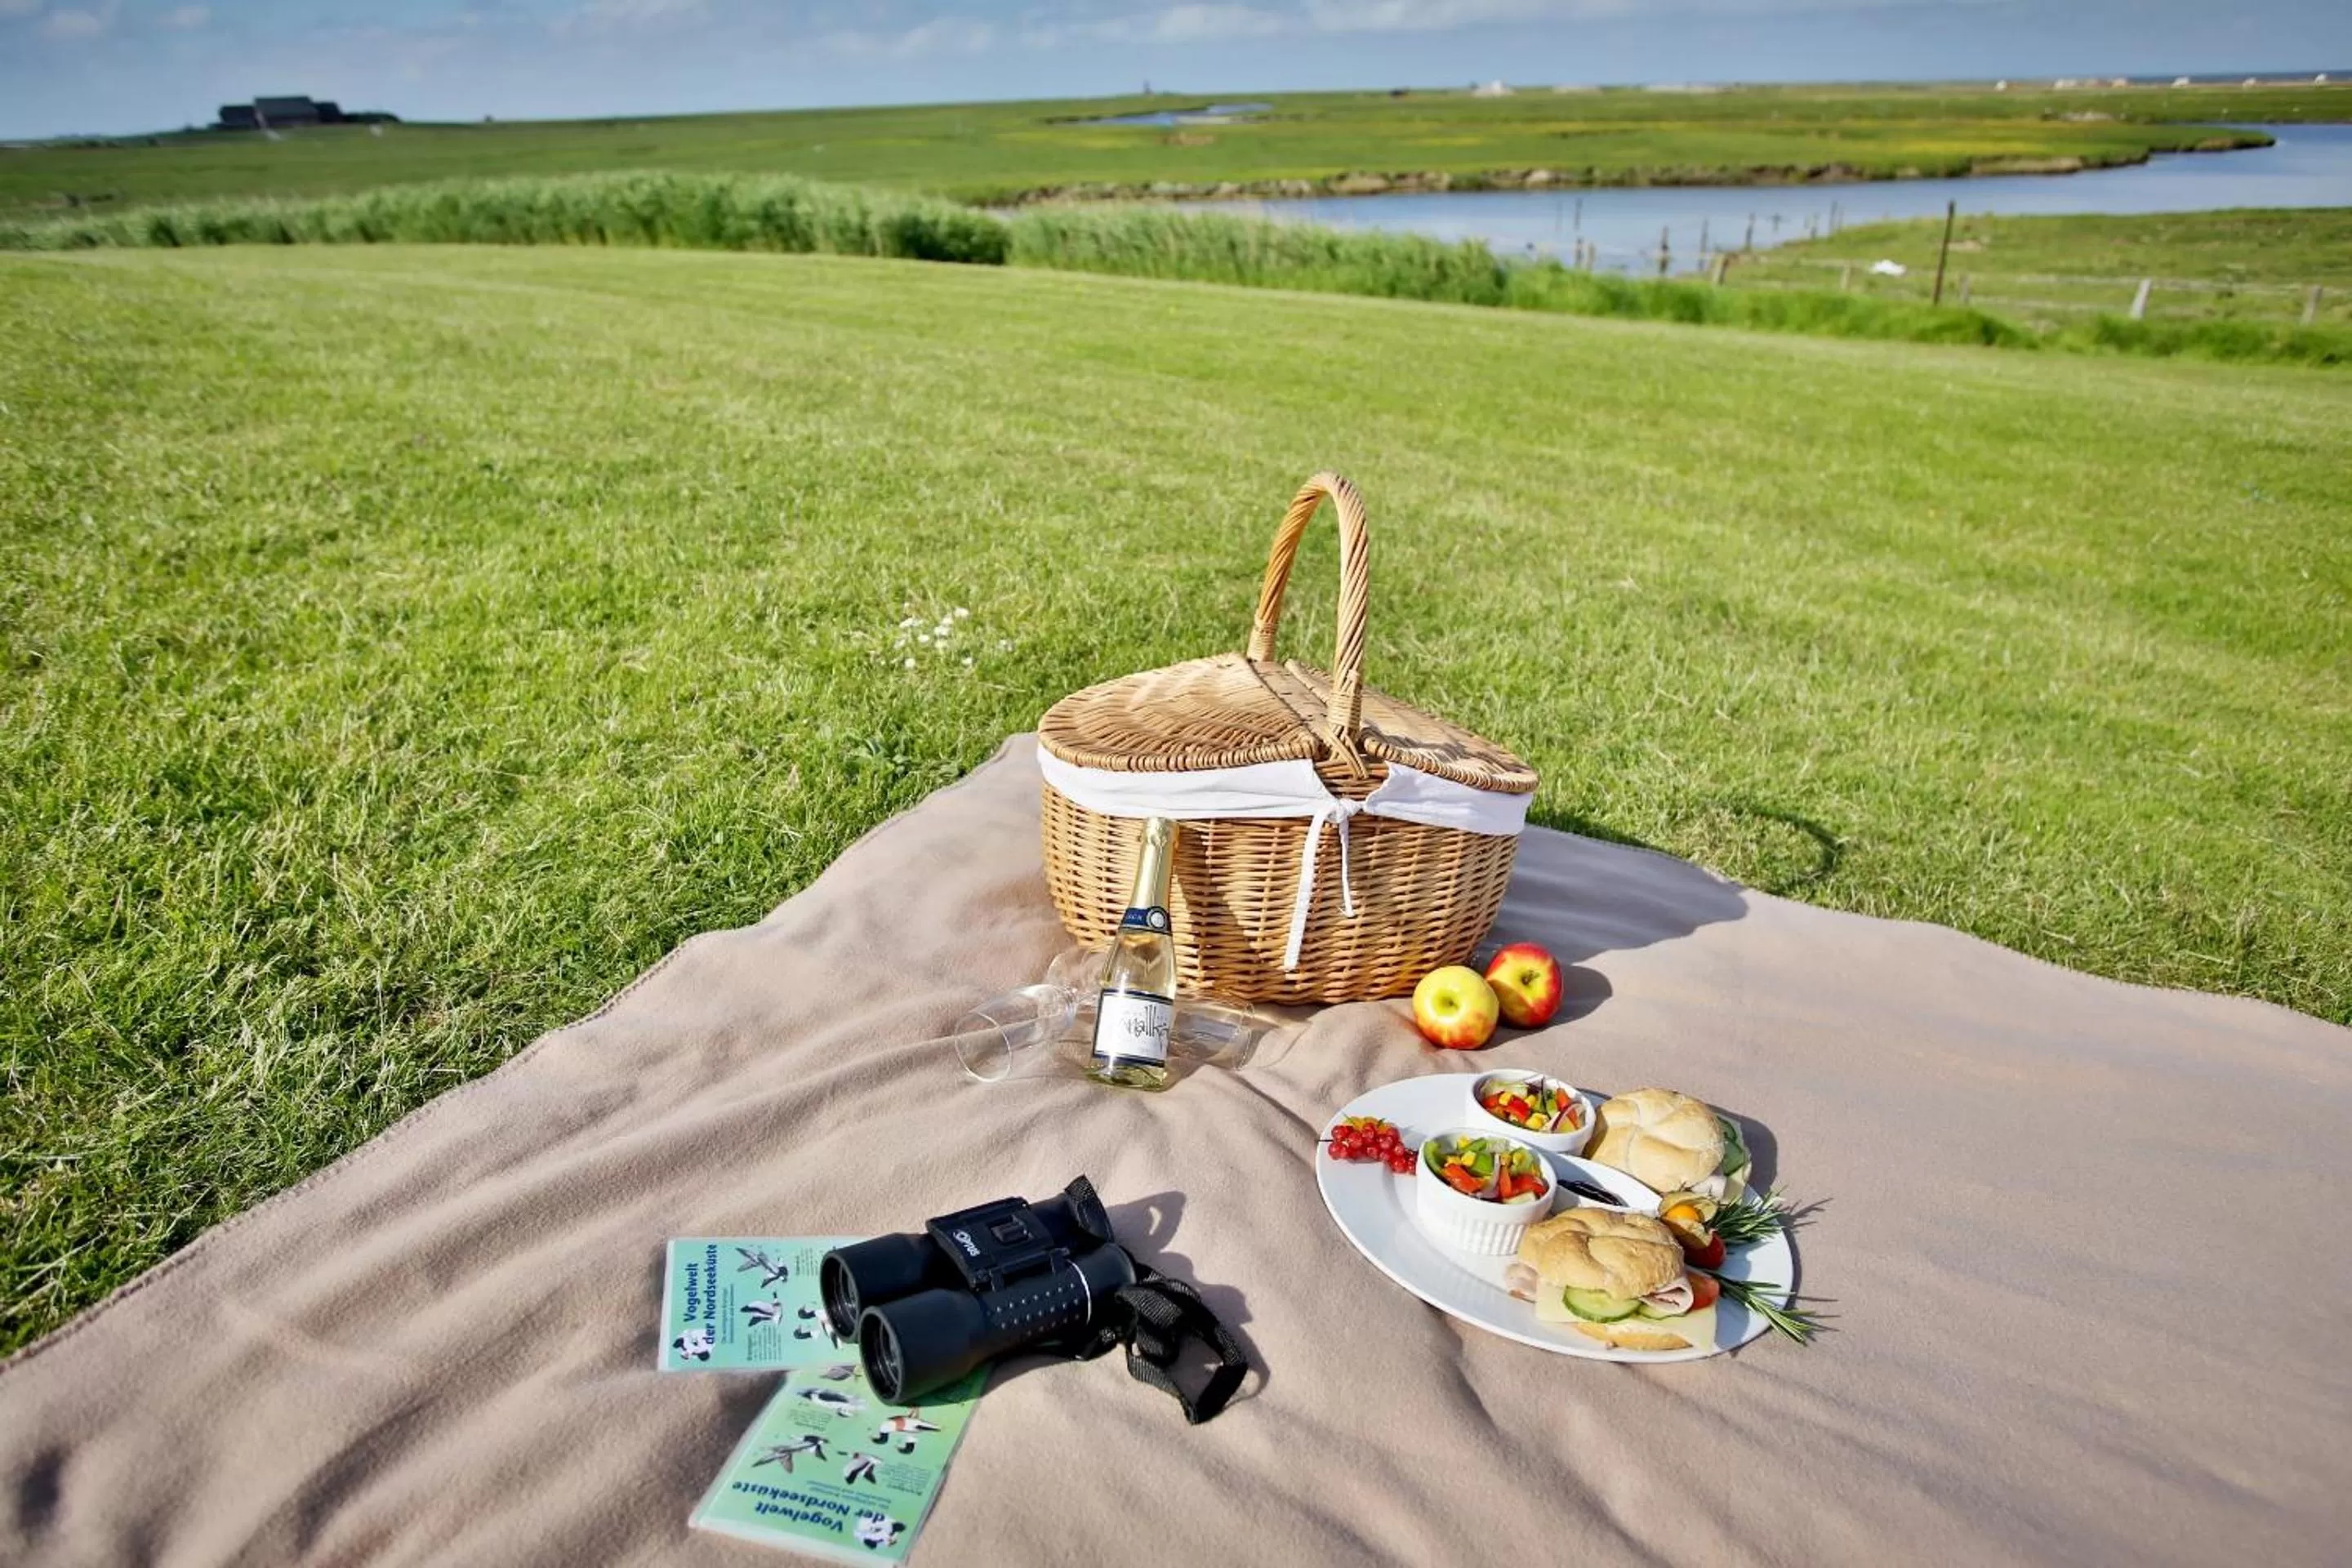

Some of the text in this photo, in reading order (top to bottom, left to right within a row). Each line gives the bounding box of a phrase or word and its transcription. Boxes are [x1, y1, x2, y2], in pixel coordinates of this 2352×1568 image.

[683, 1263, 701, 1322] Vogelwelt
[702, 1244, 718, 1345] der Nordseeküste
[732, 1481, 851, 1517] Nordseeküste
[755, 1500, 844, 1534] Vogelwelt
[854, 1506, 885, 1524] der
